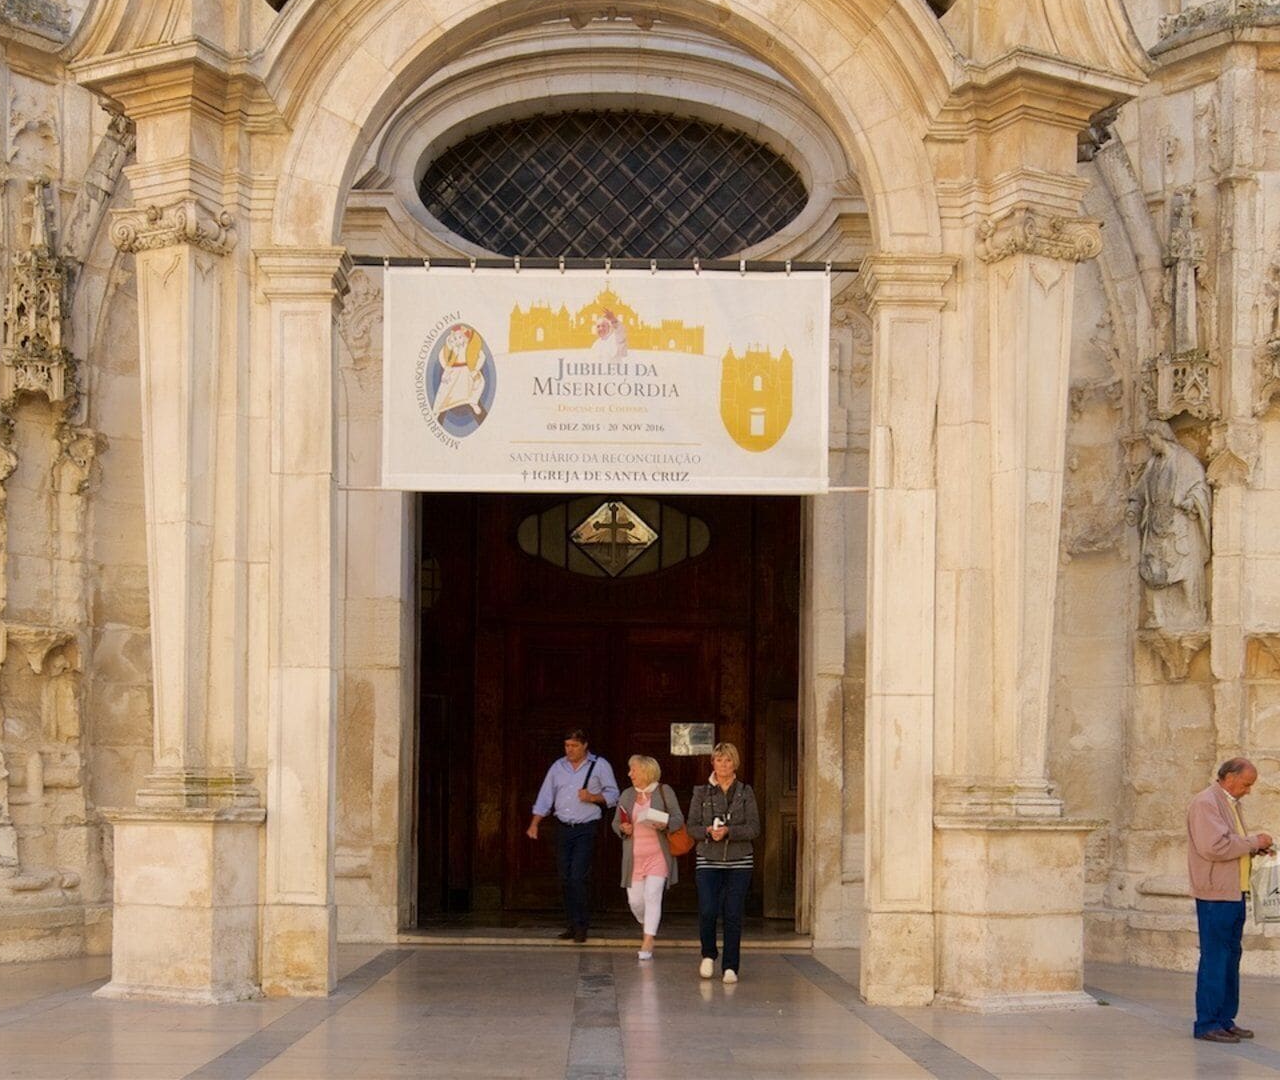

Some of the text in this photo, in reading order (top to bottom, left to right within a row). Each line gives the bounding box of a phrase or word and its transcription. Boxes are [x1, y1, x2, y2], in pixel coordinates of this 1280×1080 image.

[555, 358, 658, 381] JUBILEU DA
[532, 376, 680, 398] MISERICÓRDIA
[559, 423, 578, 431] DEZ
[622, 423, 641, 432] NOV
[645, 423, 665, 432] 2016
[509, 451, 701, 466] SANTUÁRIO DA RECONCILIAÇÃO
[531, 469, 690, 483] IGREJA DE SANTA CRUZ
